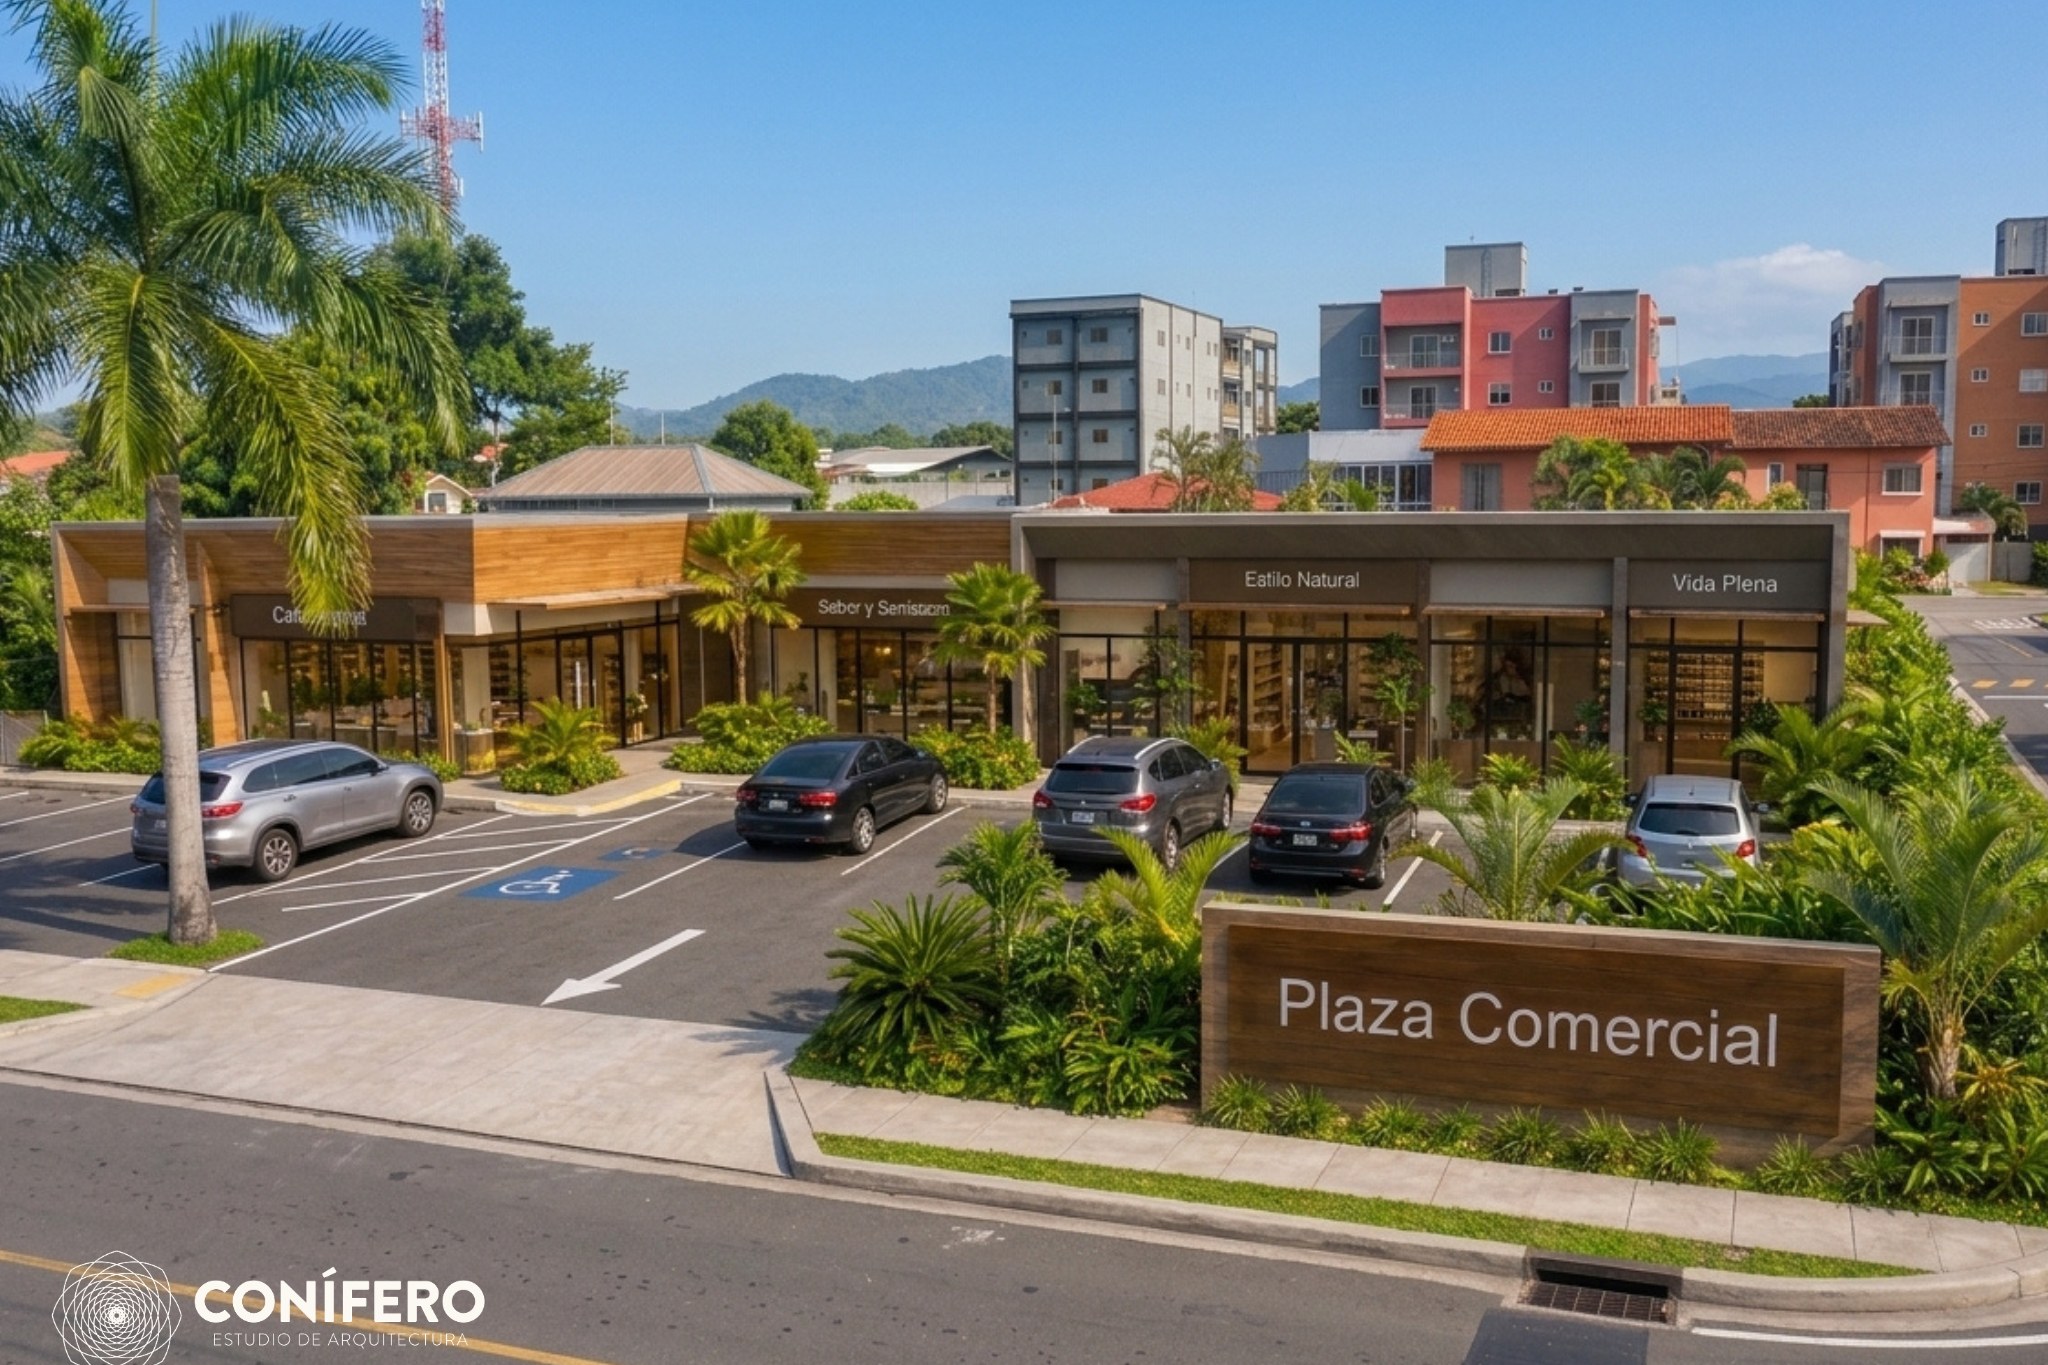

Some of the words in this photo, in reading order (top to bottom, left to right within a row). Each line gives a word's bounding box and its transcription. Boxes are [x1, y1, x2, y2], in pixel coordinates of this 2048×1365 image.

[1298, 571, 1360, 588] Natural
[1672, 573, 1716, 593] Vida
[1722, 574, 1778, 593] Plena
[864, 602, 874, 619] y
[1279, 977, 1434, 1040] Plaza
[1459, 991, 1779, 1067] Comercial
